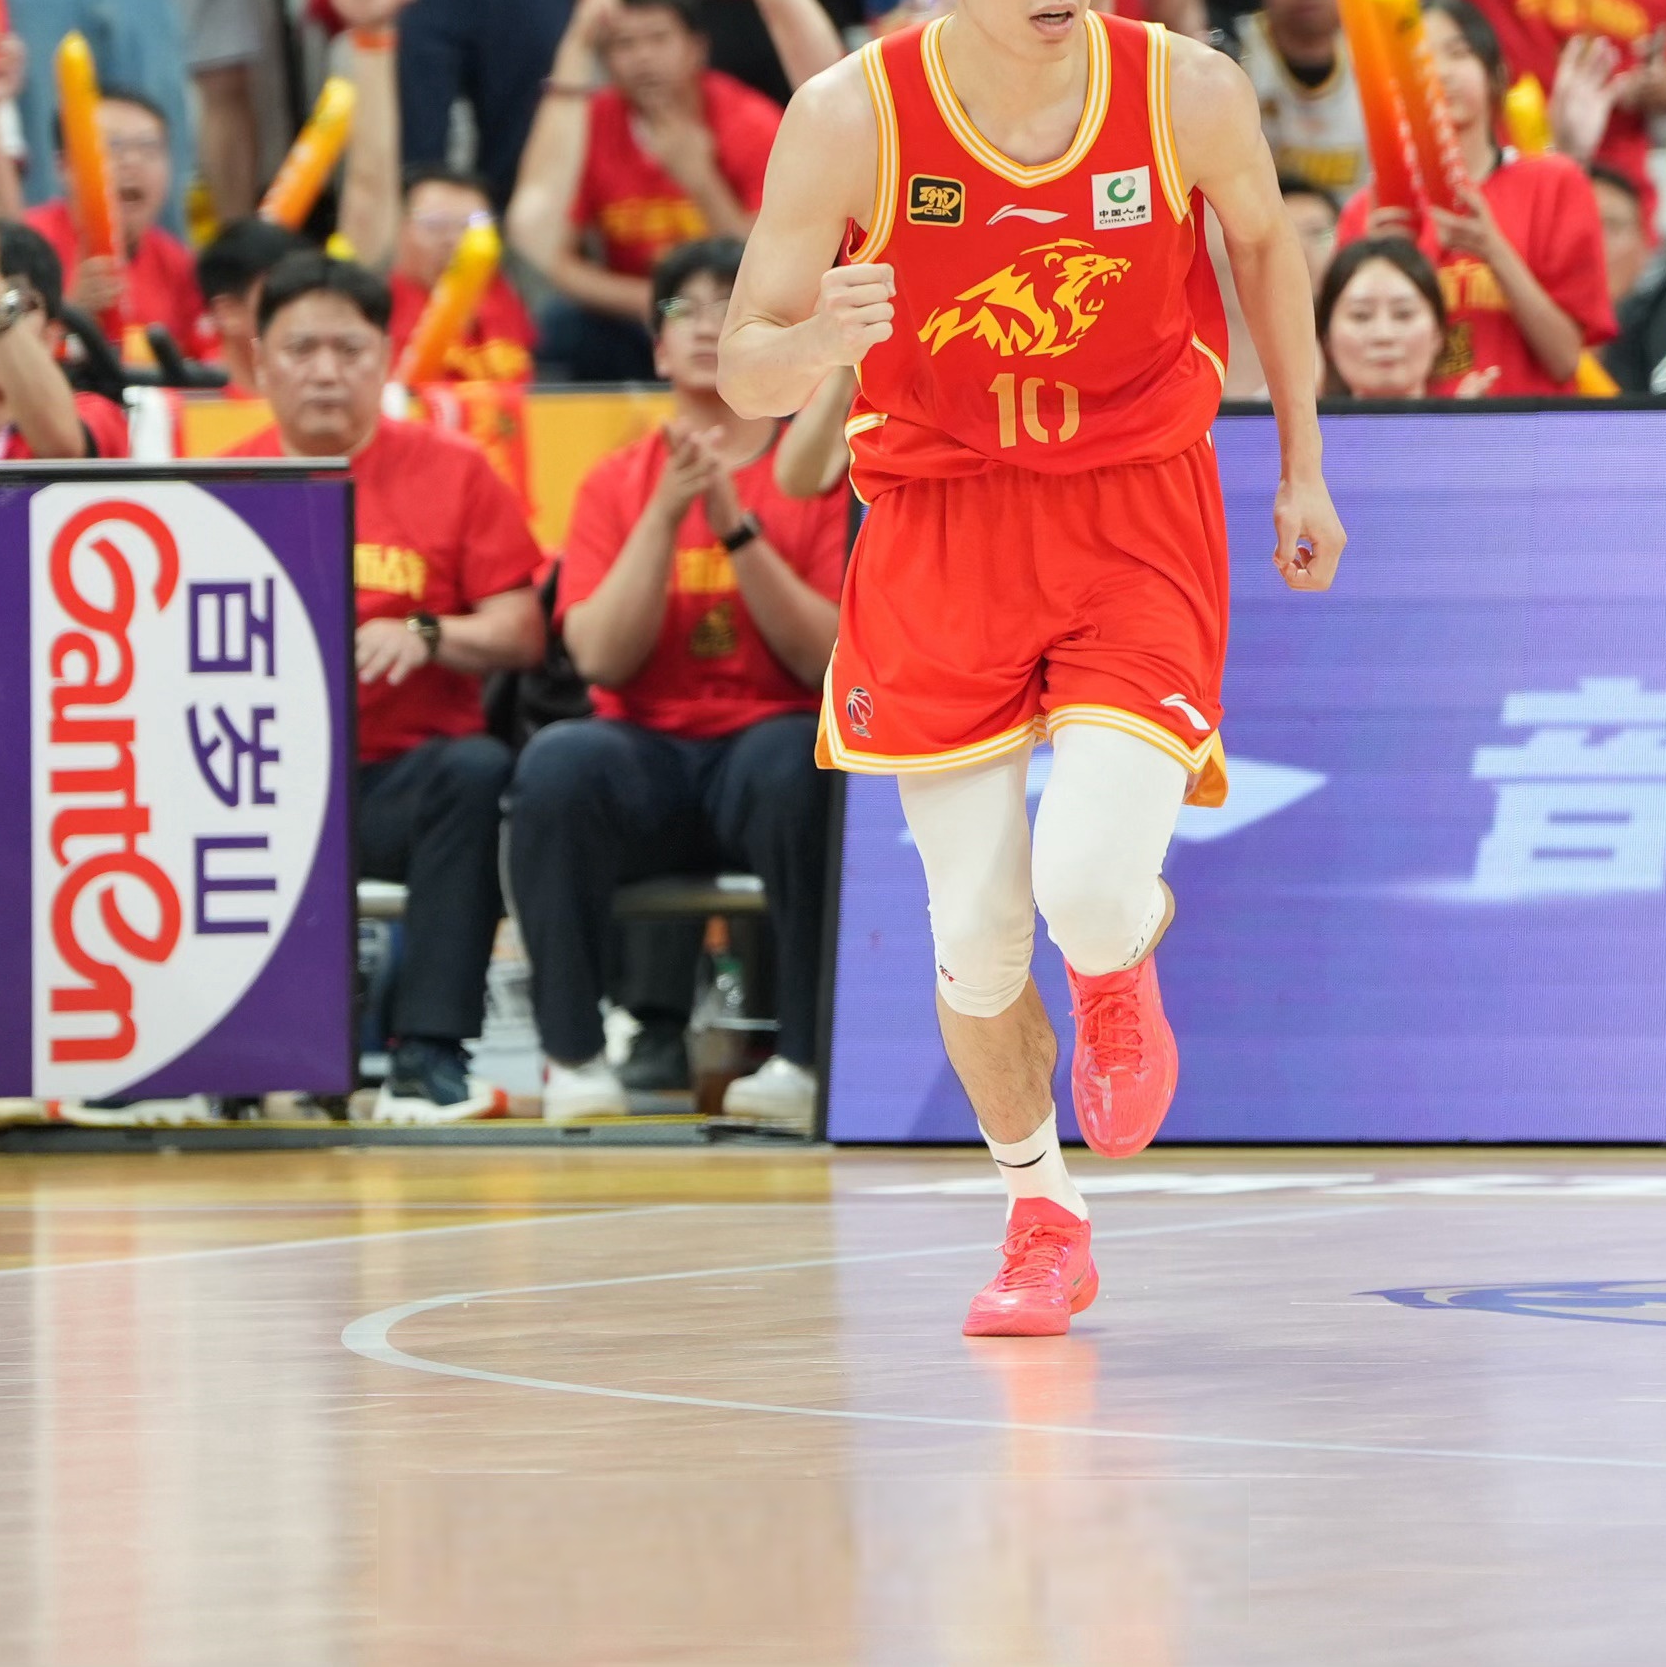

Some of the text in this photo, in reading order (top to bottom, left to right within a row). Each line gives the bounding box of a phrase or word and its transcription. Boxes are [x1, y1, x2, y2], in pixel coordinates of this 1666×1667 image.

[923, 207, 953, 217] CBA
[1099, 204, 1146, 218] 中国人寿
[1128, 213, 1146, 221] LIFE
[988, 373, 1081, 449] 10
[187, 577, 279, 937] 百岁山
